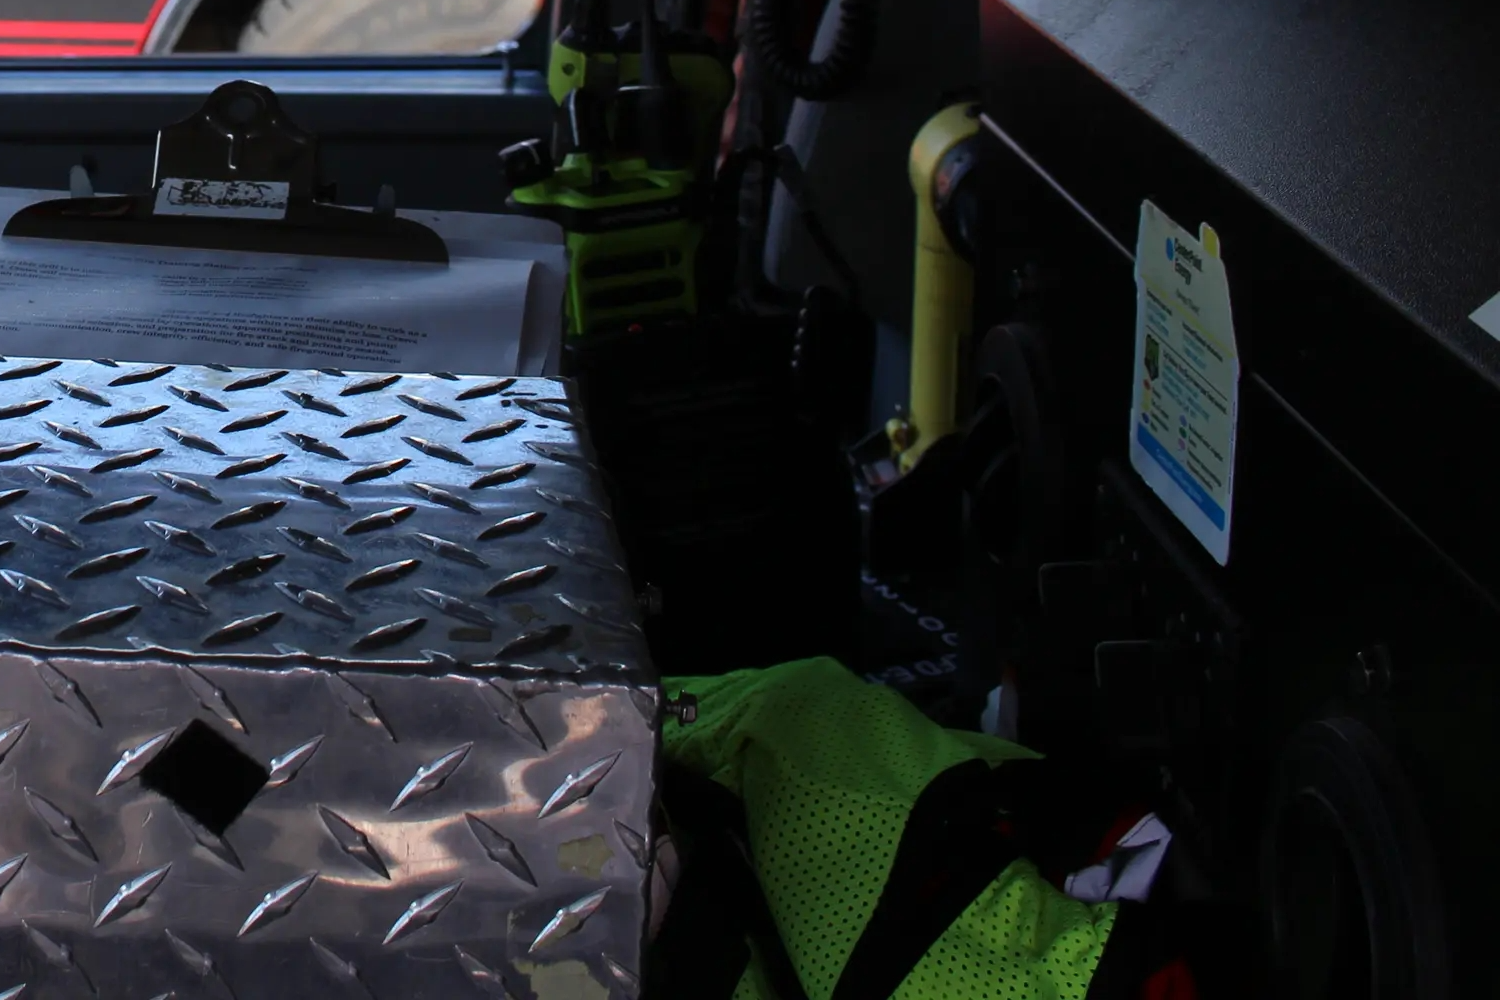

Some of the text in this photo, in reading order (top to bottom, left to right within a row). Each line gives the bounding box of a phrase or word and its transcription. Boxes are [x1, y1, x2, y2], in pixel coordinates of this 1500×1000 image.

[249, 319, 282, 327] within
[332, 319, 365, 330] ability
[379, 326, 406, 335] work
[289, 338, 310, 346] and
[345, 337, 365, 345] and
